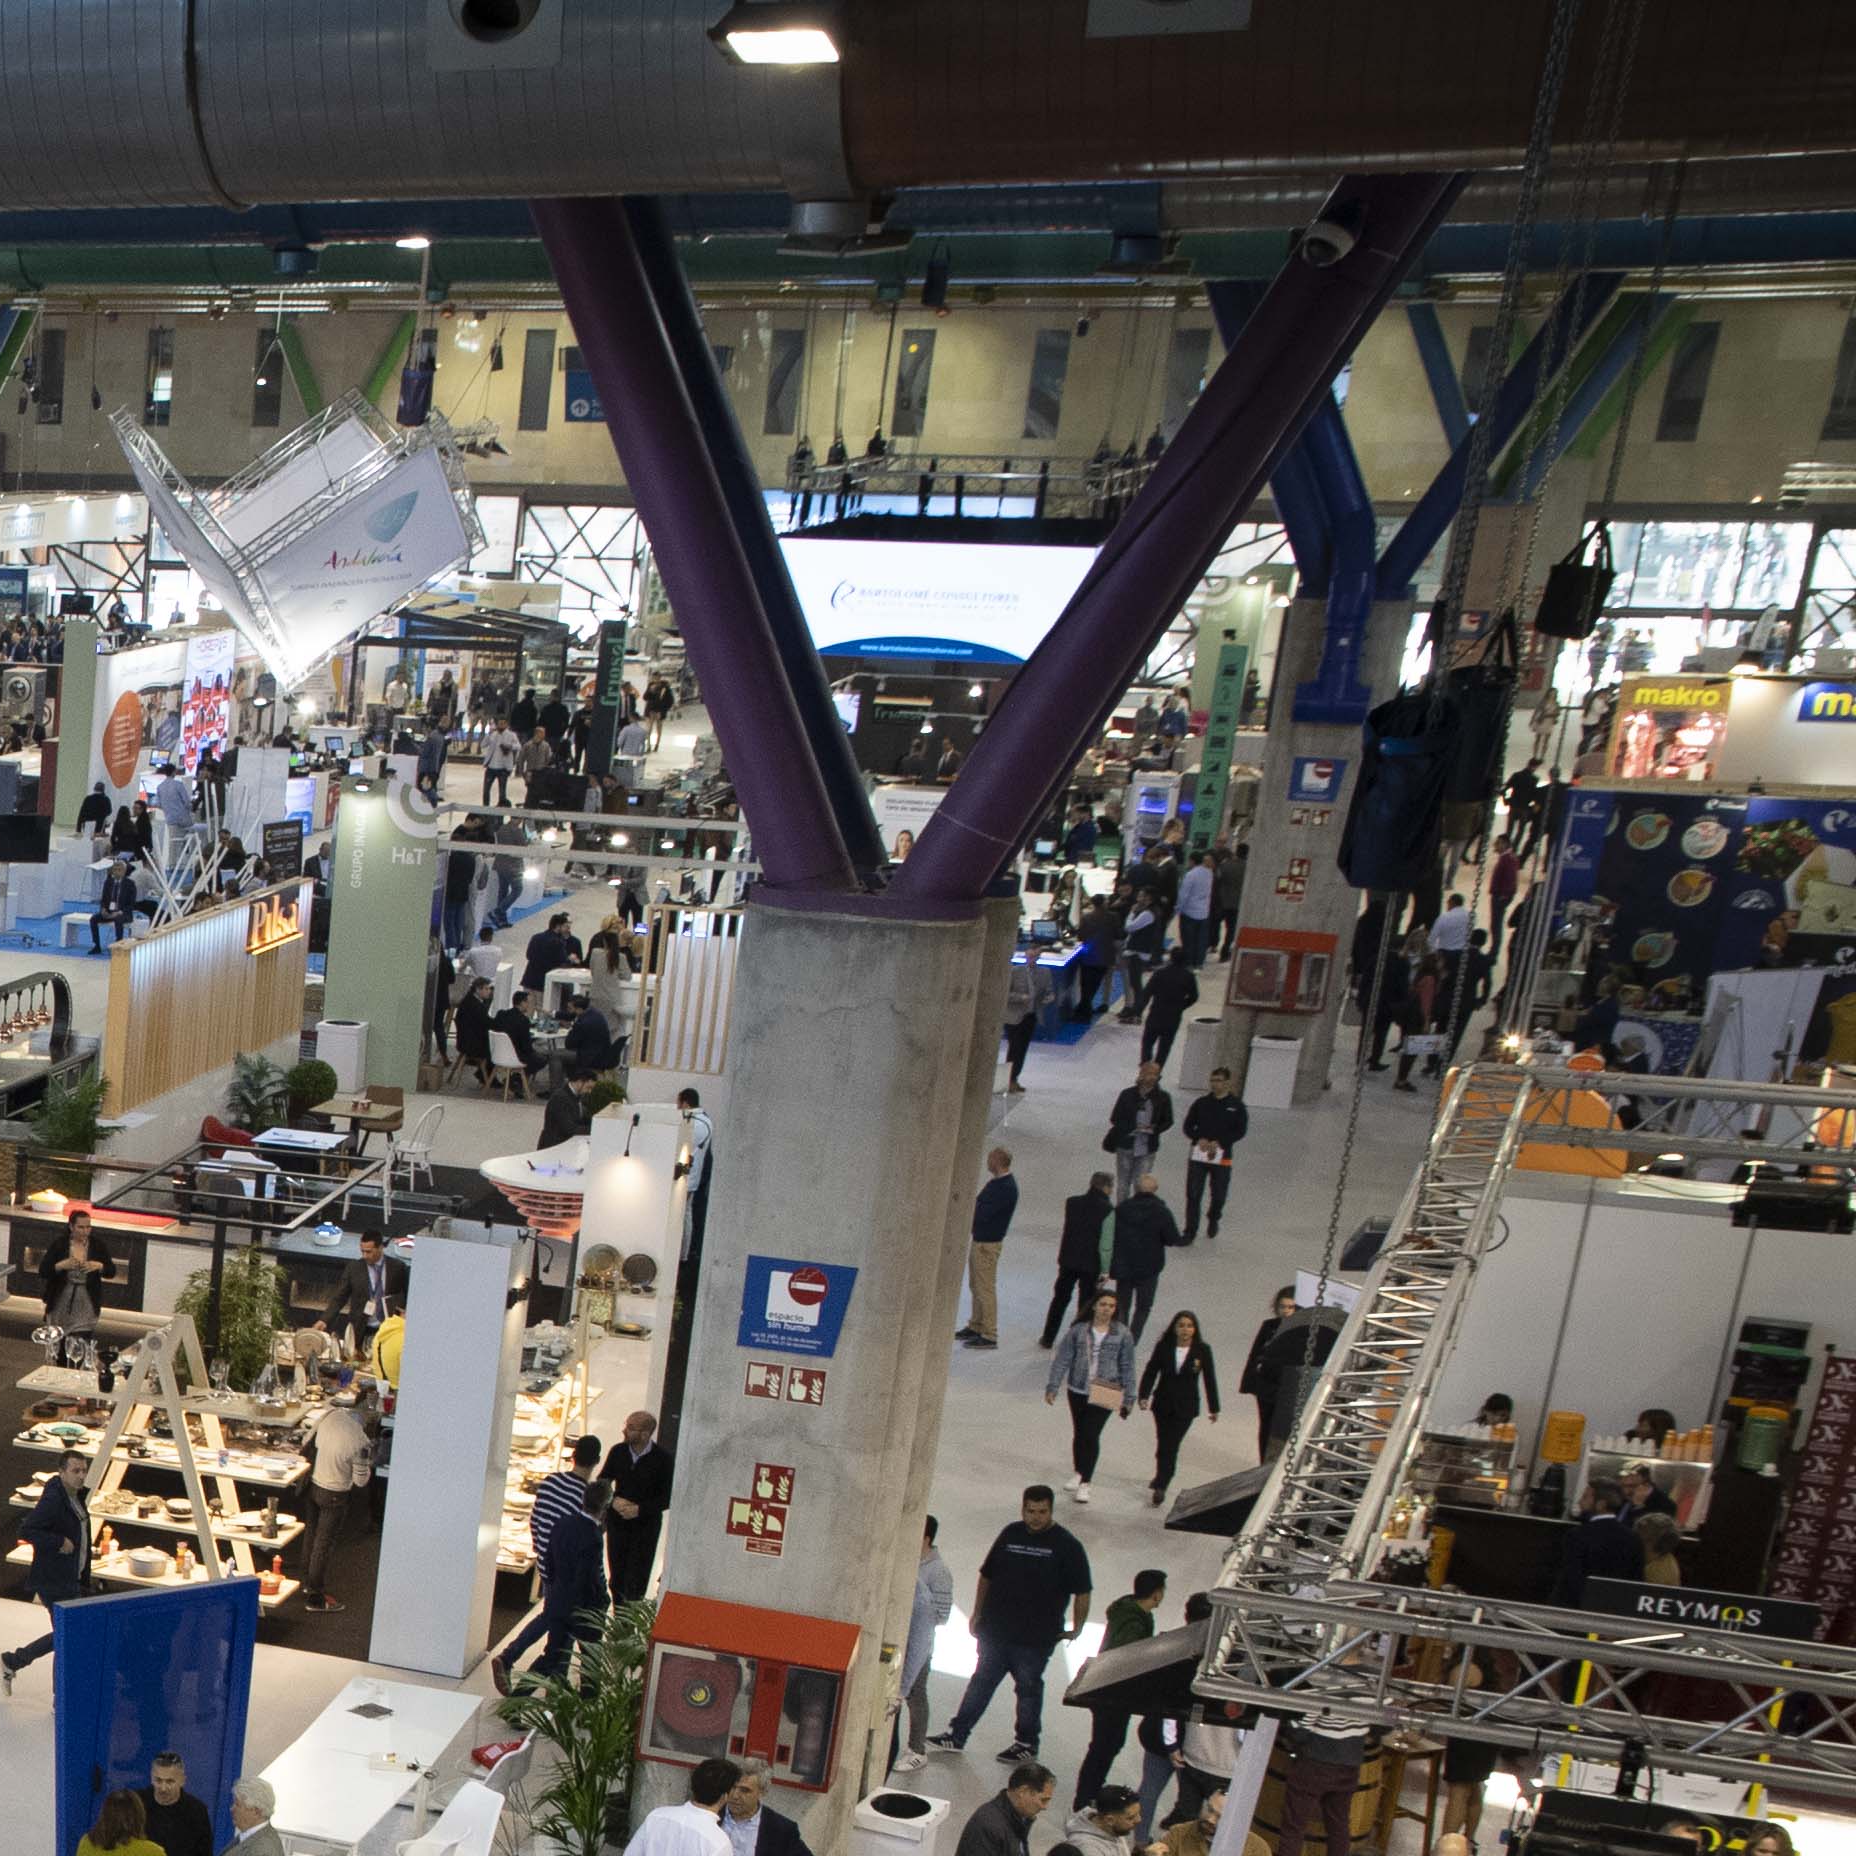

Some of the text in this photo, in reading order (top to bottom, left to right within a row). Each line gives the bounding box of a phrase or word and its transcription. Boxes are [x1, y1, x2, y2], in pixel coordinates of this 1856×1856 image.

[1633, 686, 1720, 706] makro
[392, 847, 426, 866] H&T
[251, 895, 298, 947] Pilsa
[768, 1310, 804, 1323] espacio
[767, 1321, 811, 1333] sin humo
[1637, 1595, 1763, 1628] REYMOS
